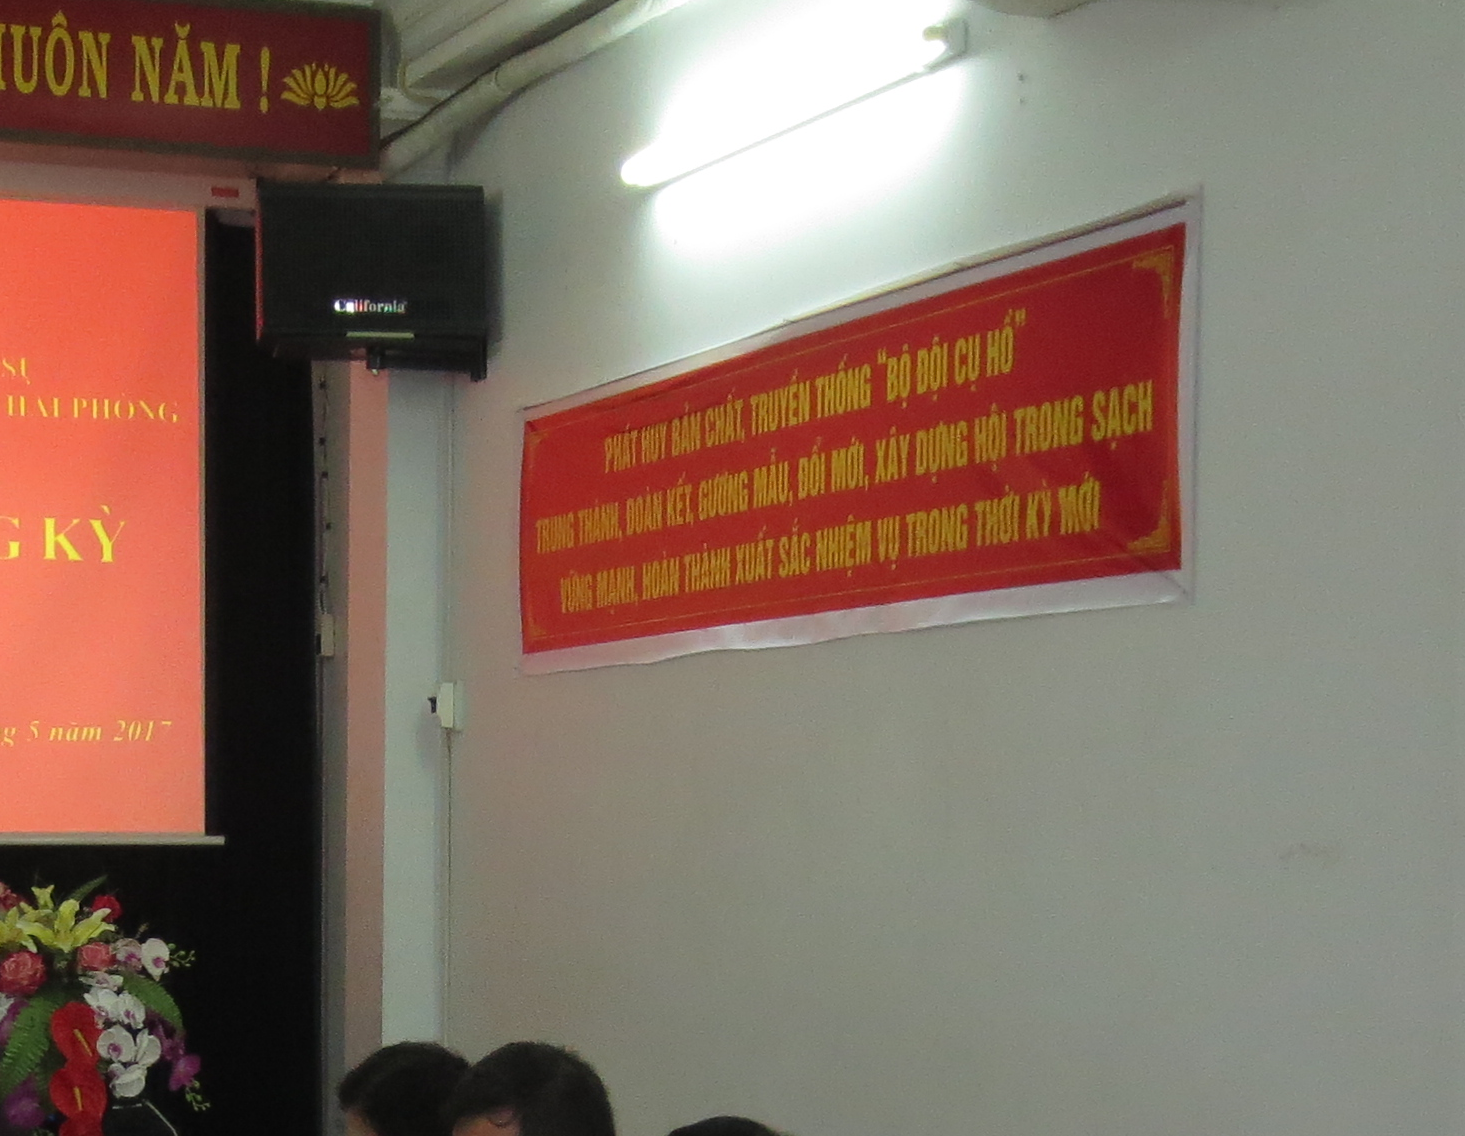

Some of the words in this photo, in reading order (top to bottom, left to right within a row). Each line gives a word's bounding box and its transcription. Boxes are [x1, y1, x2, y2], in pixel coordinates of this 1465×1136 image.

[131, 22, 241, 110] NĂM
[333, 298, 405, 314] California
[640, 421, 668, 464] HUY
[1013, 395, 1085, 457] TRONG
[1091, 379, 1153, 451] SẠCH
[42, 505, 127, 564] KỲ
[815, 514, 873, 577] NHIỆM
[906, 503, 970, 557] TRONG
[27, 720, 41, 742] 5
[113, 719, 173, 742] 2017
